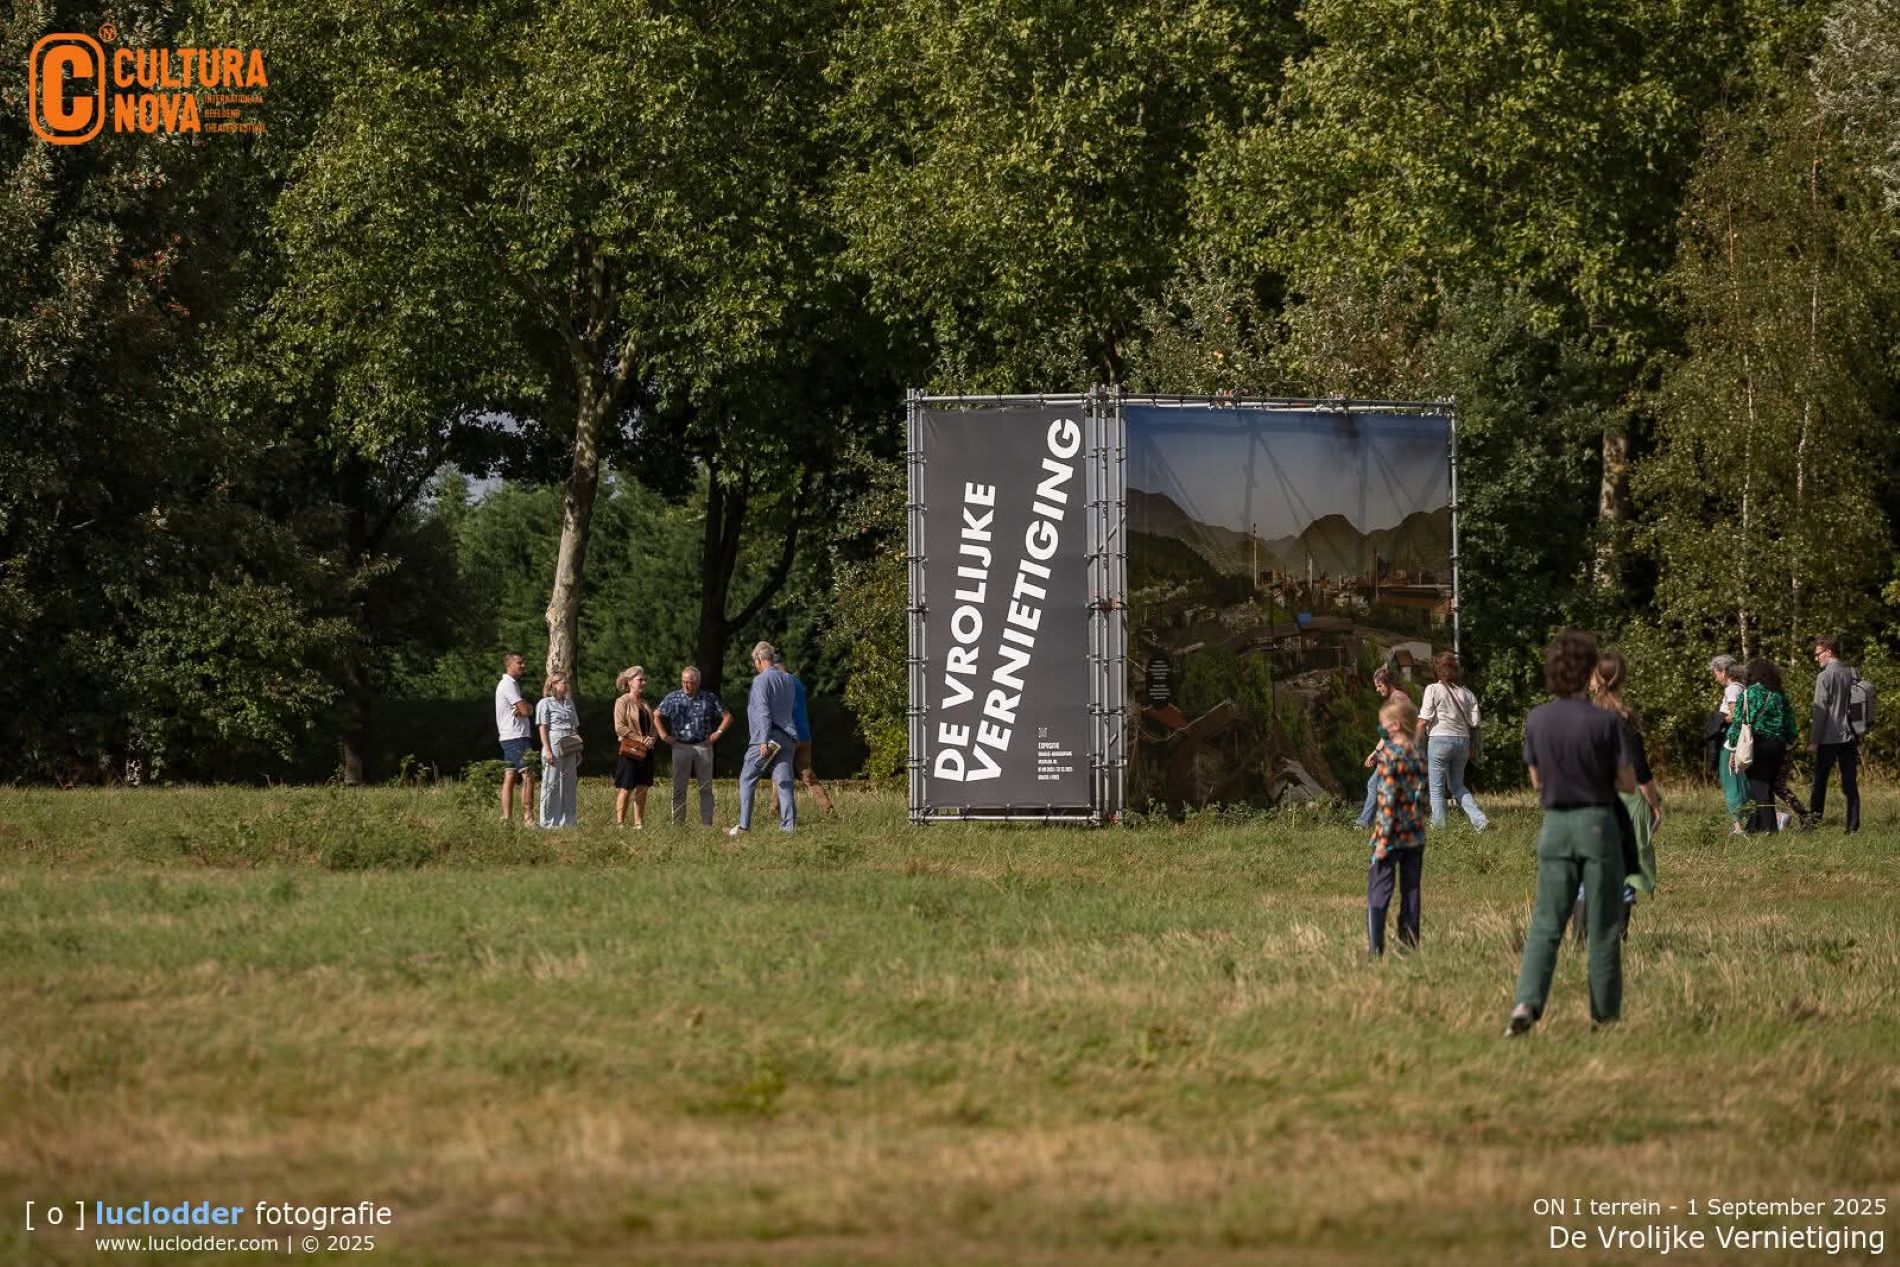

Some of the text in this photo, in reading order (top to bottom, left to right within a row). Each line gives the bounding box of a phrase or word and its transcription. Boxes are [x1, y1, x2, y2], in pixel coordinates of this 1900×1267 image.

[934, 482, 996, 782] DE VROLIJKE
[965, 418, 1081, 782] VERNIETIGING
